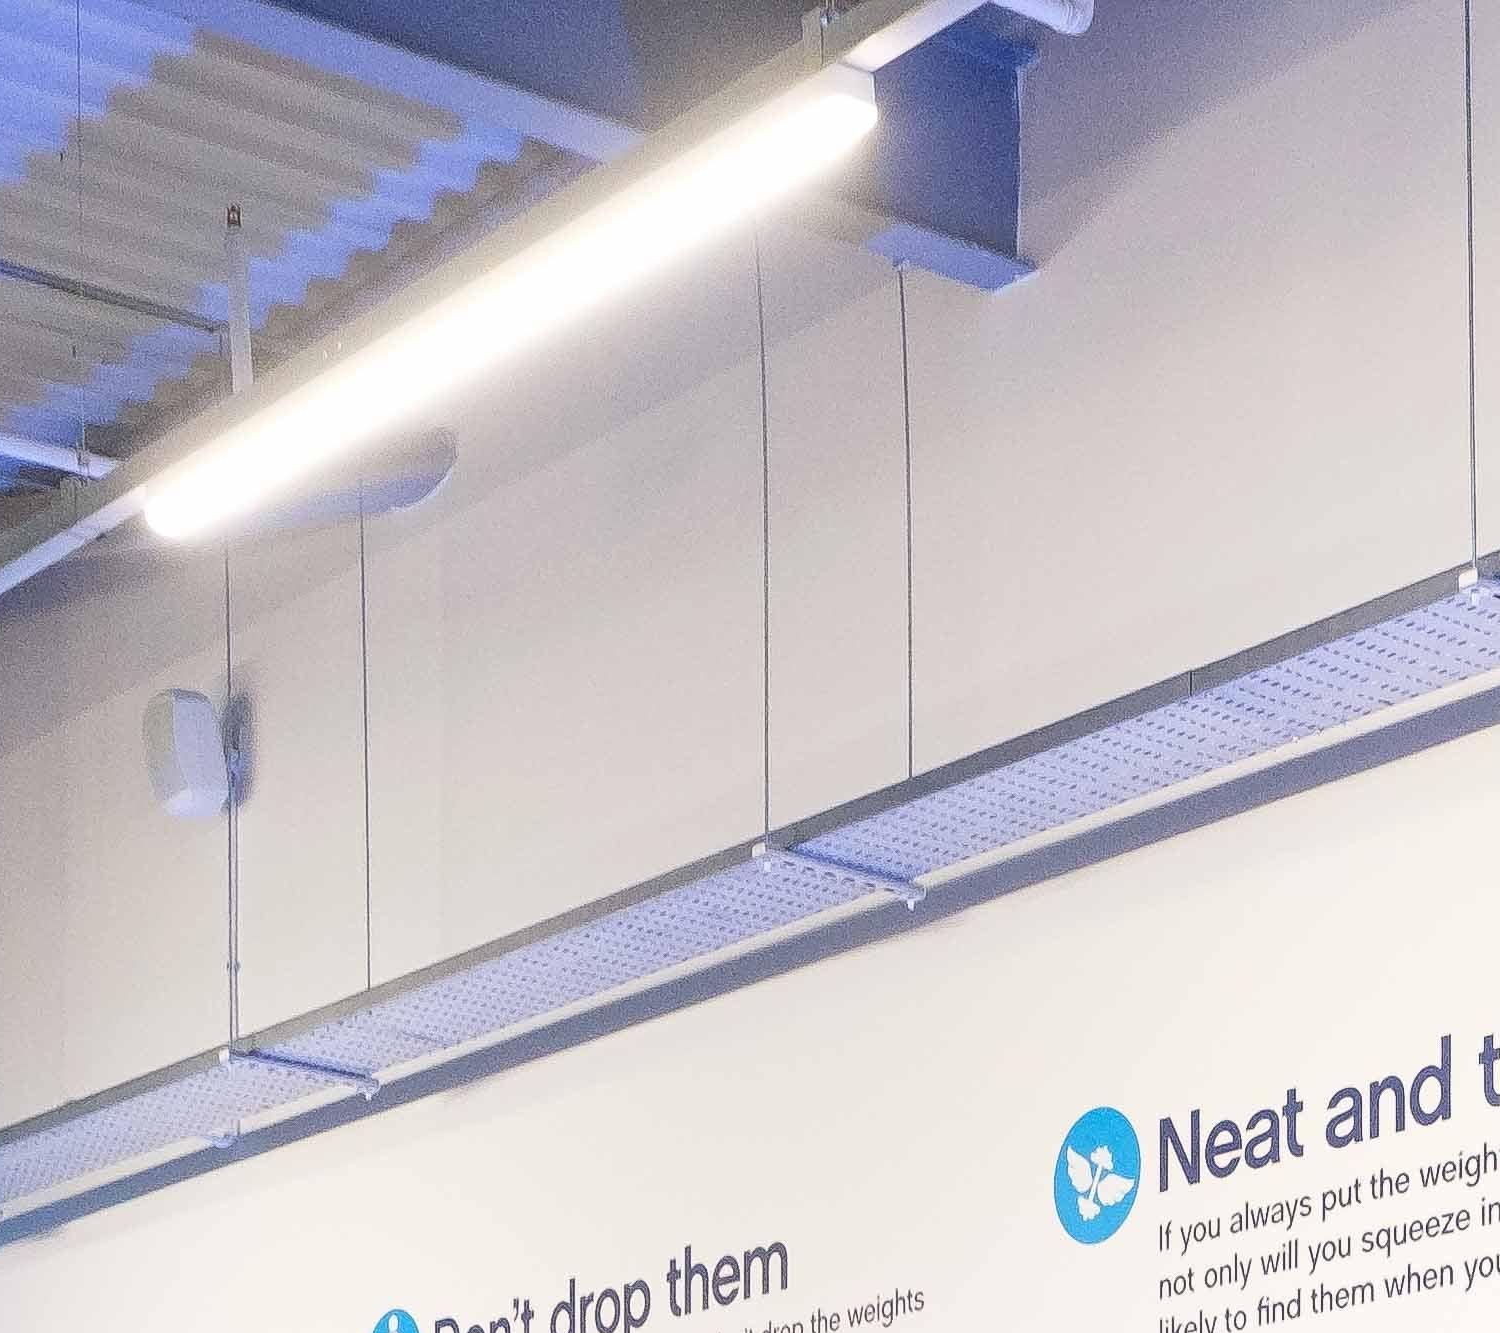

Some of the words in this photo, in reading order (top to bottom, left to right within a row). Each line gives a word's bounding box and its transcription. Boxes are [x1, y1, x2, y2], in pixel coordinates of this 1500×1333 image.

[1160, 1088, 1304, 1192] Neat
[1326, 1034, 1451, 1148] and
[1160, 1220, 1172, 1252] If
[1180, 1217, 1220, 1256] you
[1230, 1196, 1311, 1234] always
[1322, 1178, 1361, 1222] put
[1370, 1168, 1409, 1200] the
[666, 1241, 788, 1317] them
[1160, 1267, 1194, 1300] not
[1205, 1253, 1252, 1290] only
[1261, 1238, 1298, 1275] will
[1308, 1236, 1351, 1275] you
[1362, 1209, 1470, 1258] squeeze
[847, 1288, 924, 1328] weights
[1225, 1308, 1246, 1333] to
[1257, 1288, 1301, 1326] find
[1311, 1282, 1374, 1314] them
[1384, 1264, 1453, 1298] when
